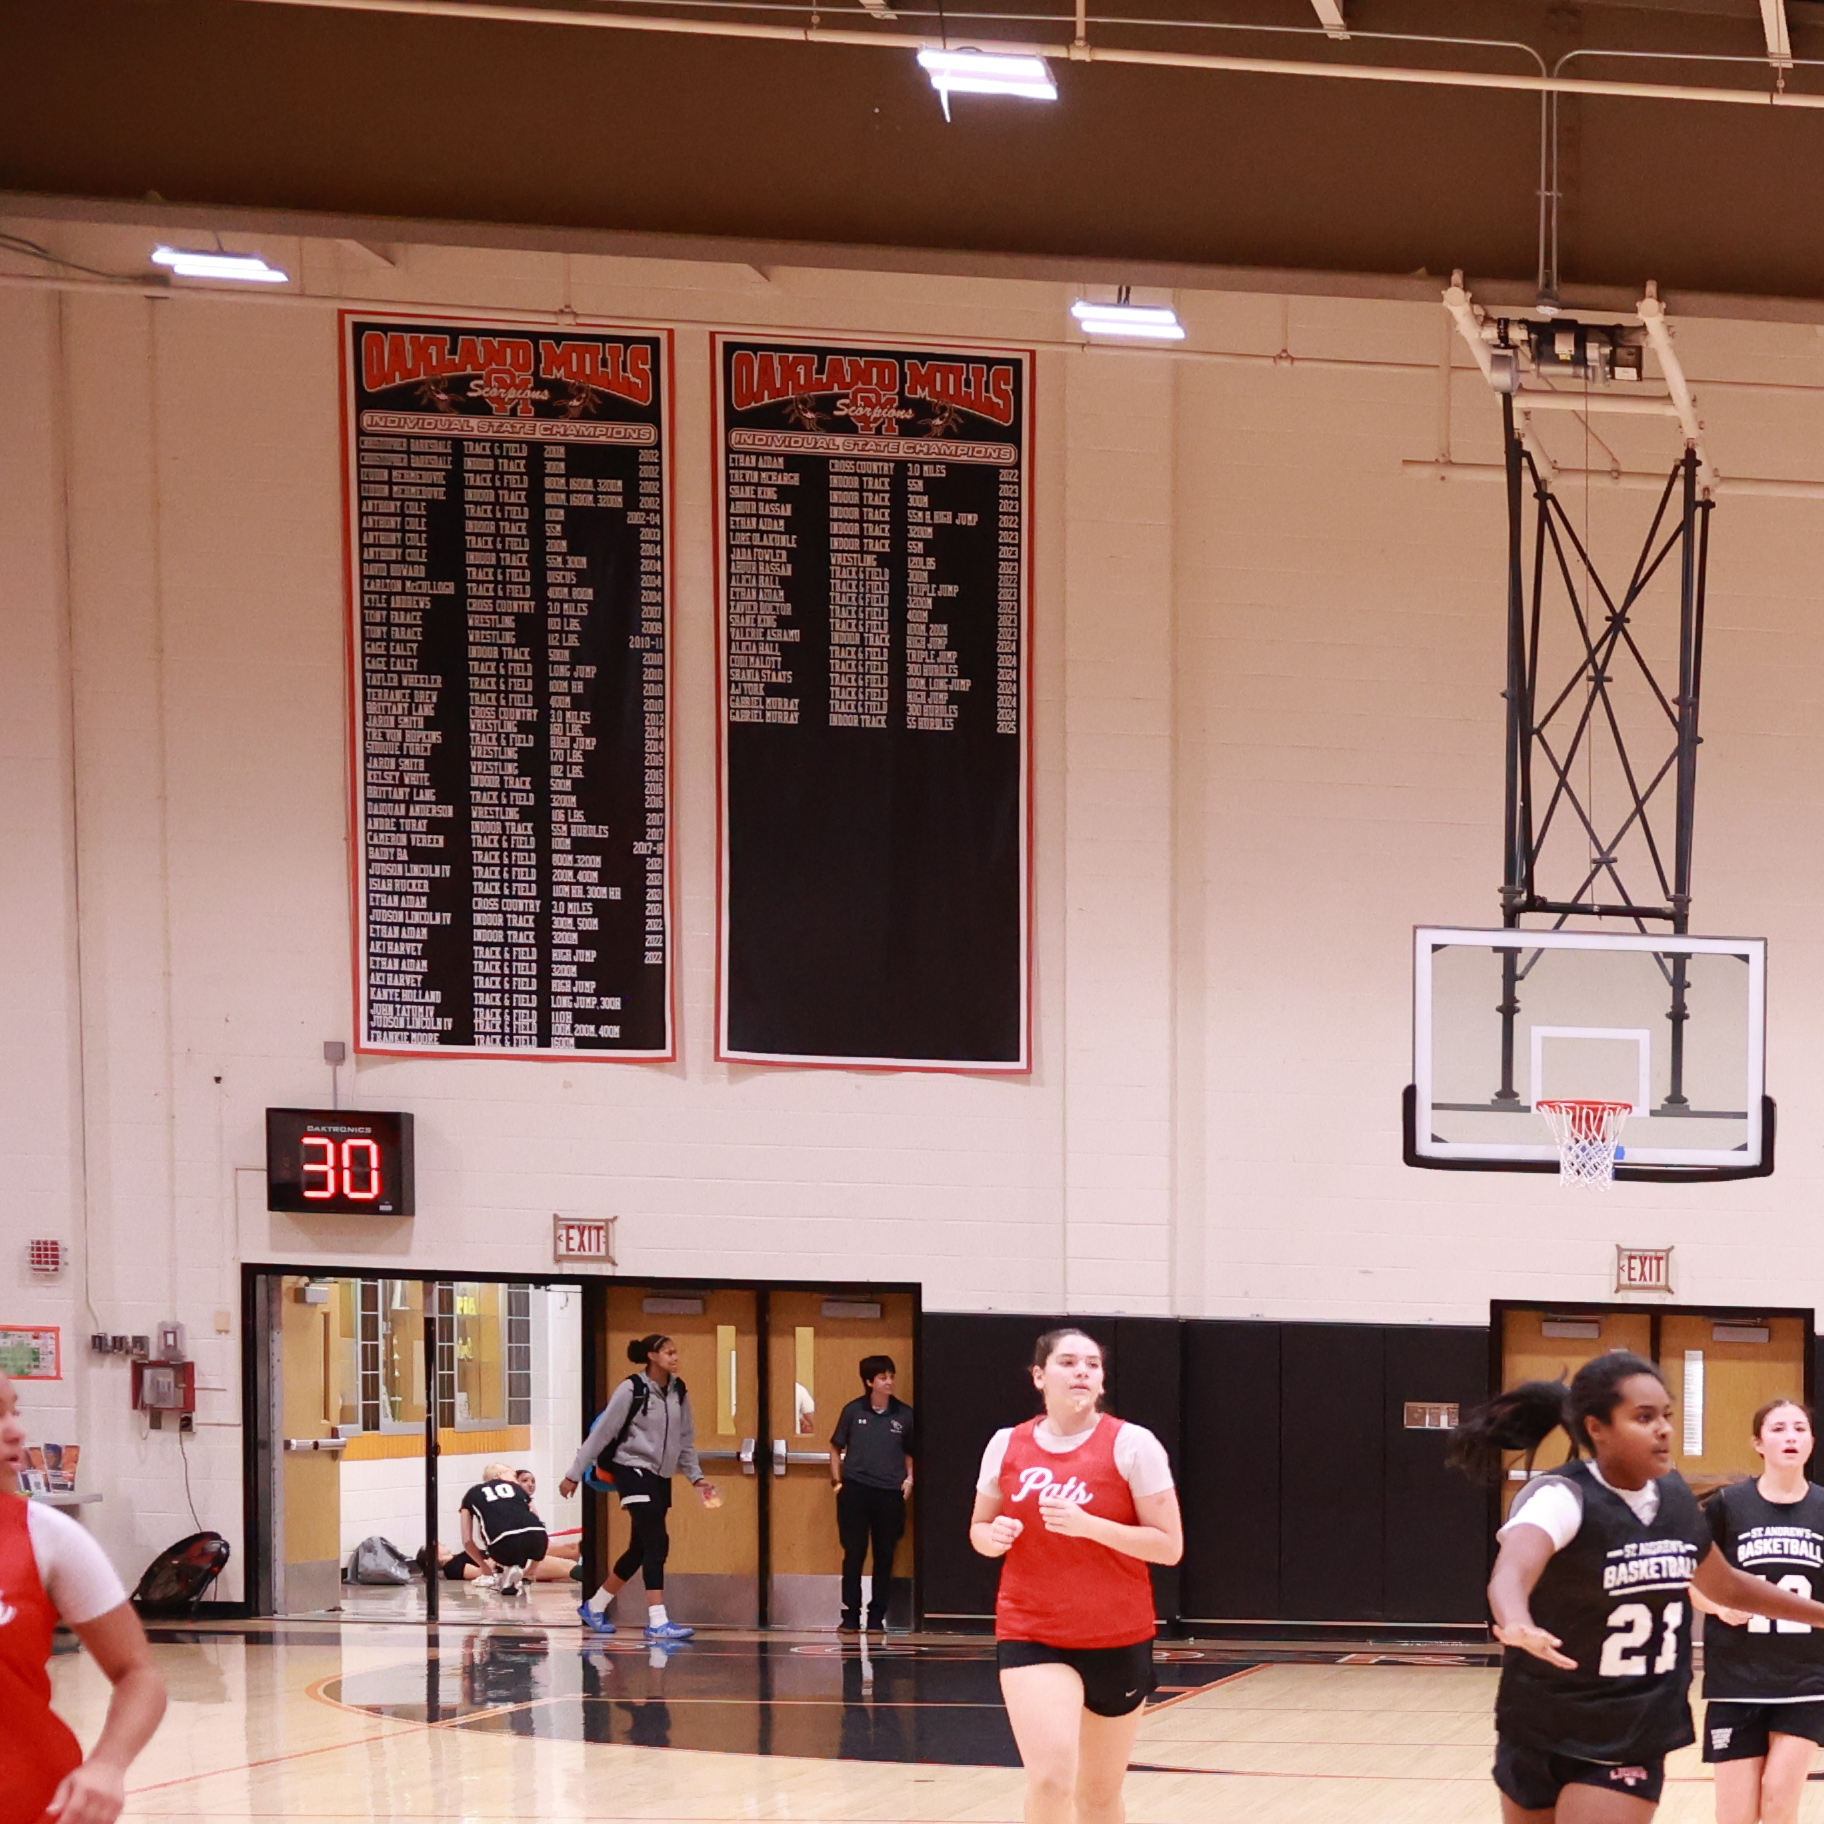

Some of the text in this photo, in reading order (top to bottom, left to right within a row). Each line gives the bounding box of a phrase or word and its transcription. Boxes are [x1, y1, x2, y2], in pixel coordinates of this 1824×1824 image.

[361, 331, 652, 406] OAKLAND MILLS
[466, 381, 550, 401] Scorpions
[731, 350, 1014, 426] OAKLAND MILLS
[833, 399, 915, 420] Scorpions
[366, 415, 650, 440] INDIVIDUAL STATE CHAMPIONS
[734, 433, 1011, 460] INDIVIDUAL STATE CHAMPIONS
[386, 942, 423, 956] HARVEY
[306, 1125, 372, 1134] DAKTRONICS
[302, 1137, 379, 1199] 30
[565, 1225, 604, 1253] EXIT
[1628, 1255, 1664, 1282] EXIT
[481, 1483, 516, 1502] 10
[1011, 1467, 1094, 1505] Pats
[1764, 1526, 1812, 1539] ANDREW'S
[1737, 1538, 1824, 1564] BASKETBALL
[1599, 1602, 1684, 1676] 21
